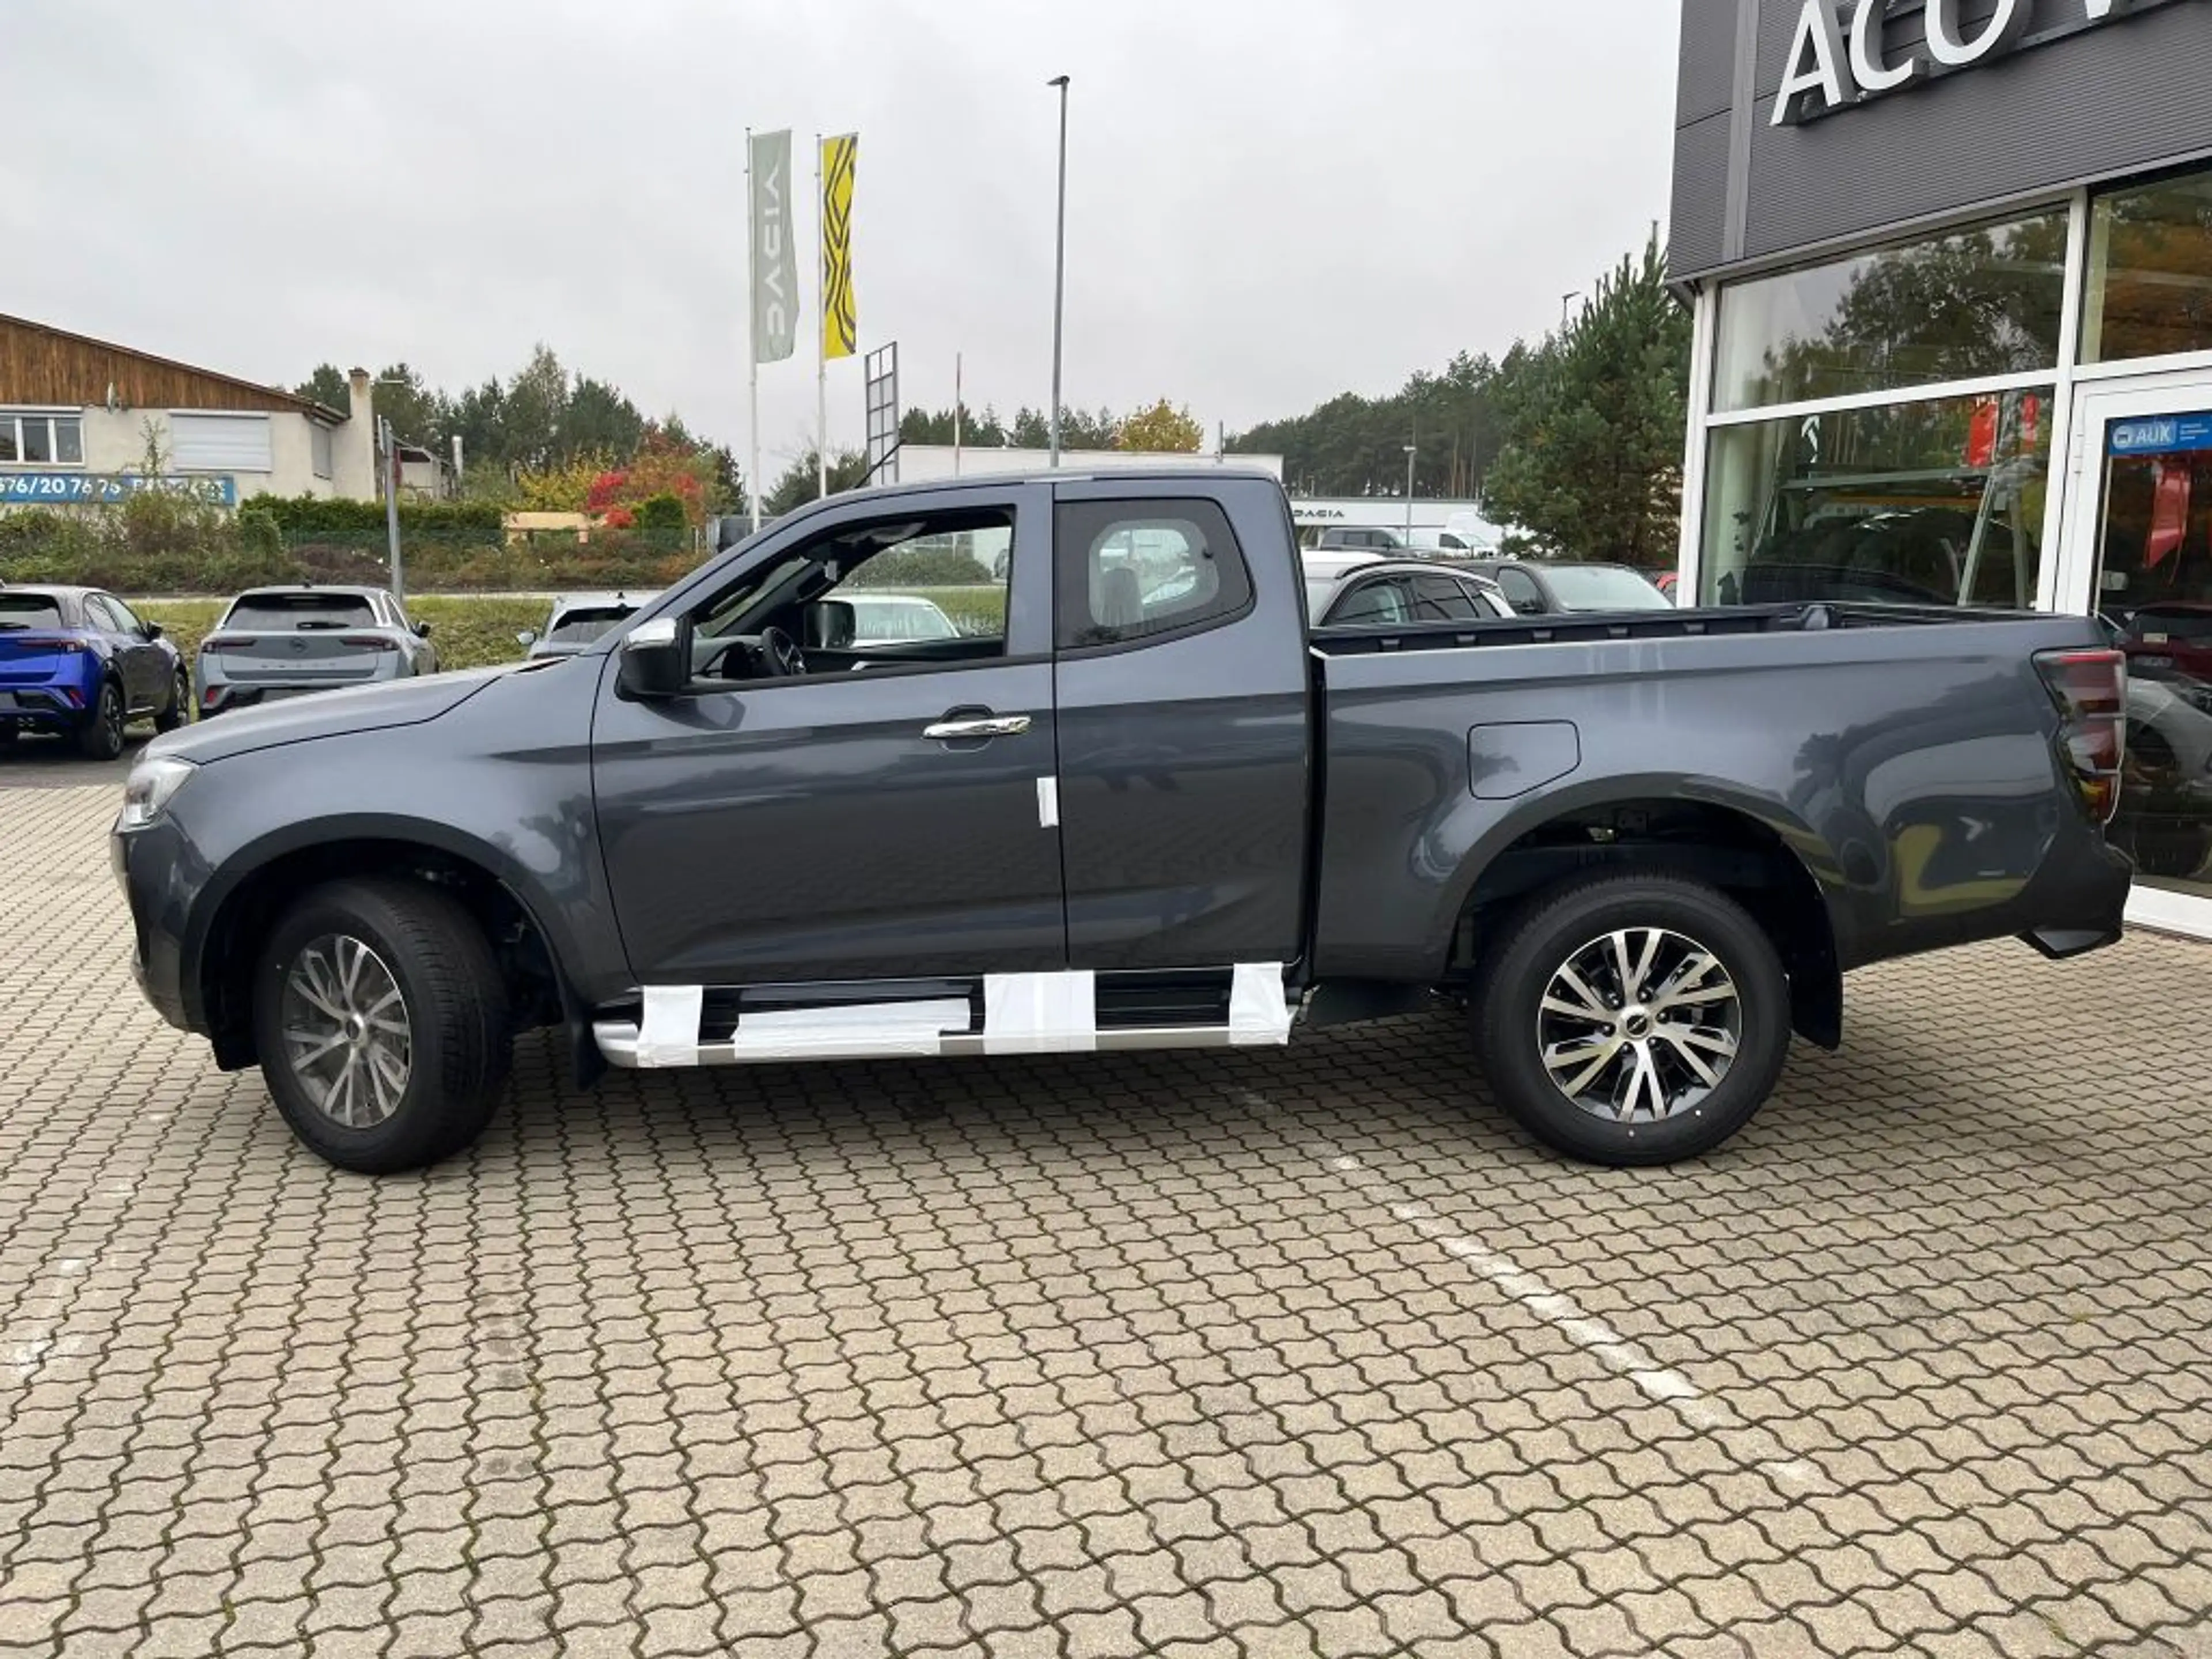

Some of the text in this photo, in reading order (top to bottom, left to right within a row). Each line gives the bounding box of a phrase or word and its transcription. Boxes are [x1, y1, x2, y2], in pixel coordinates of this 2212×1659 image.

[1769, 0, 2018, 127] ACO
[70, 477, 93, 495] 76
[1293, 510, 1344, 518] DACIA
